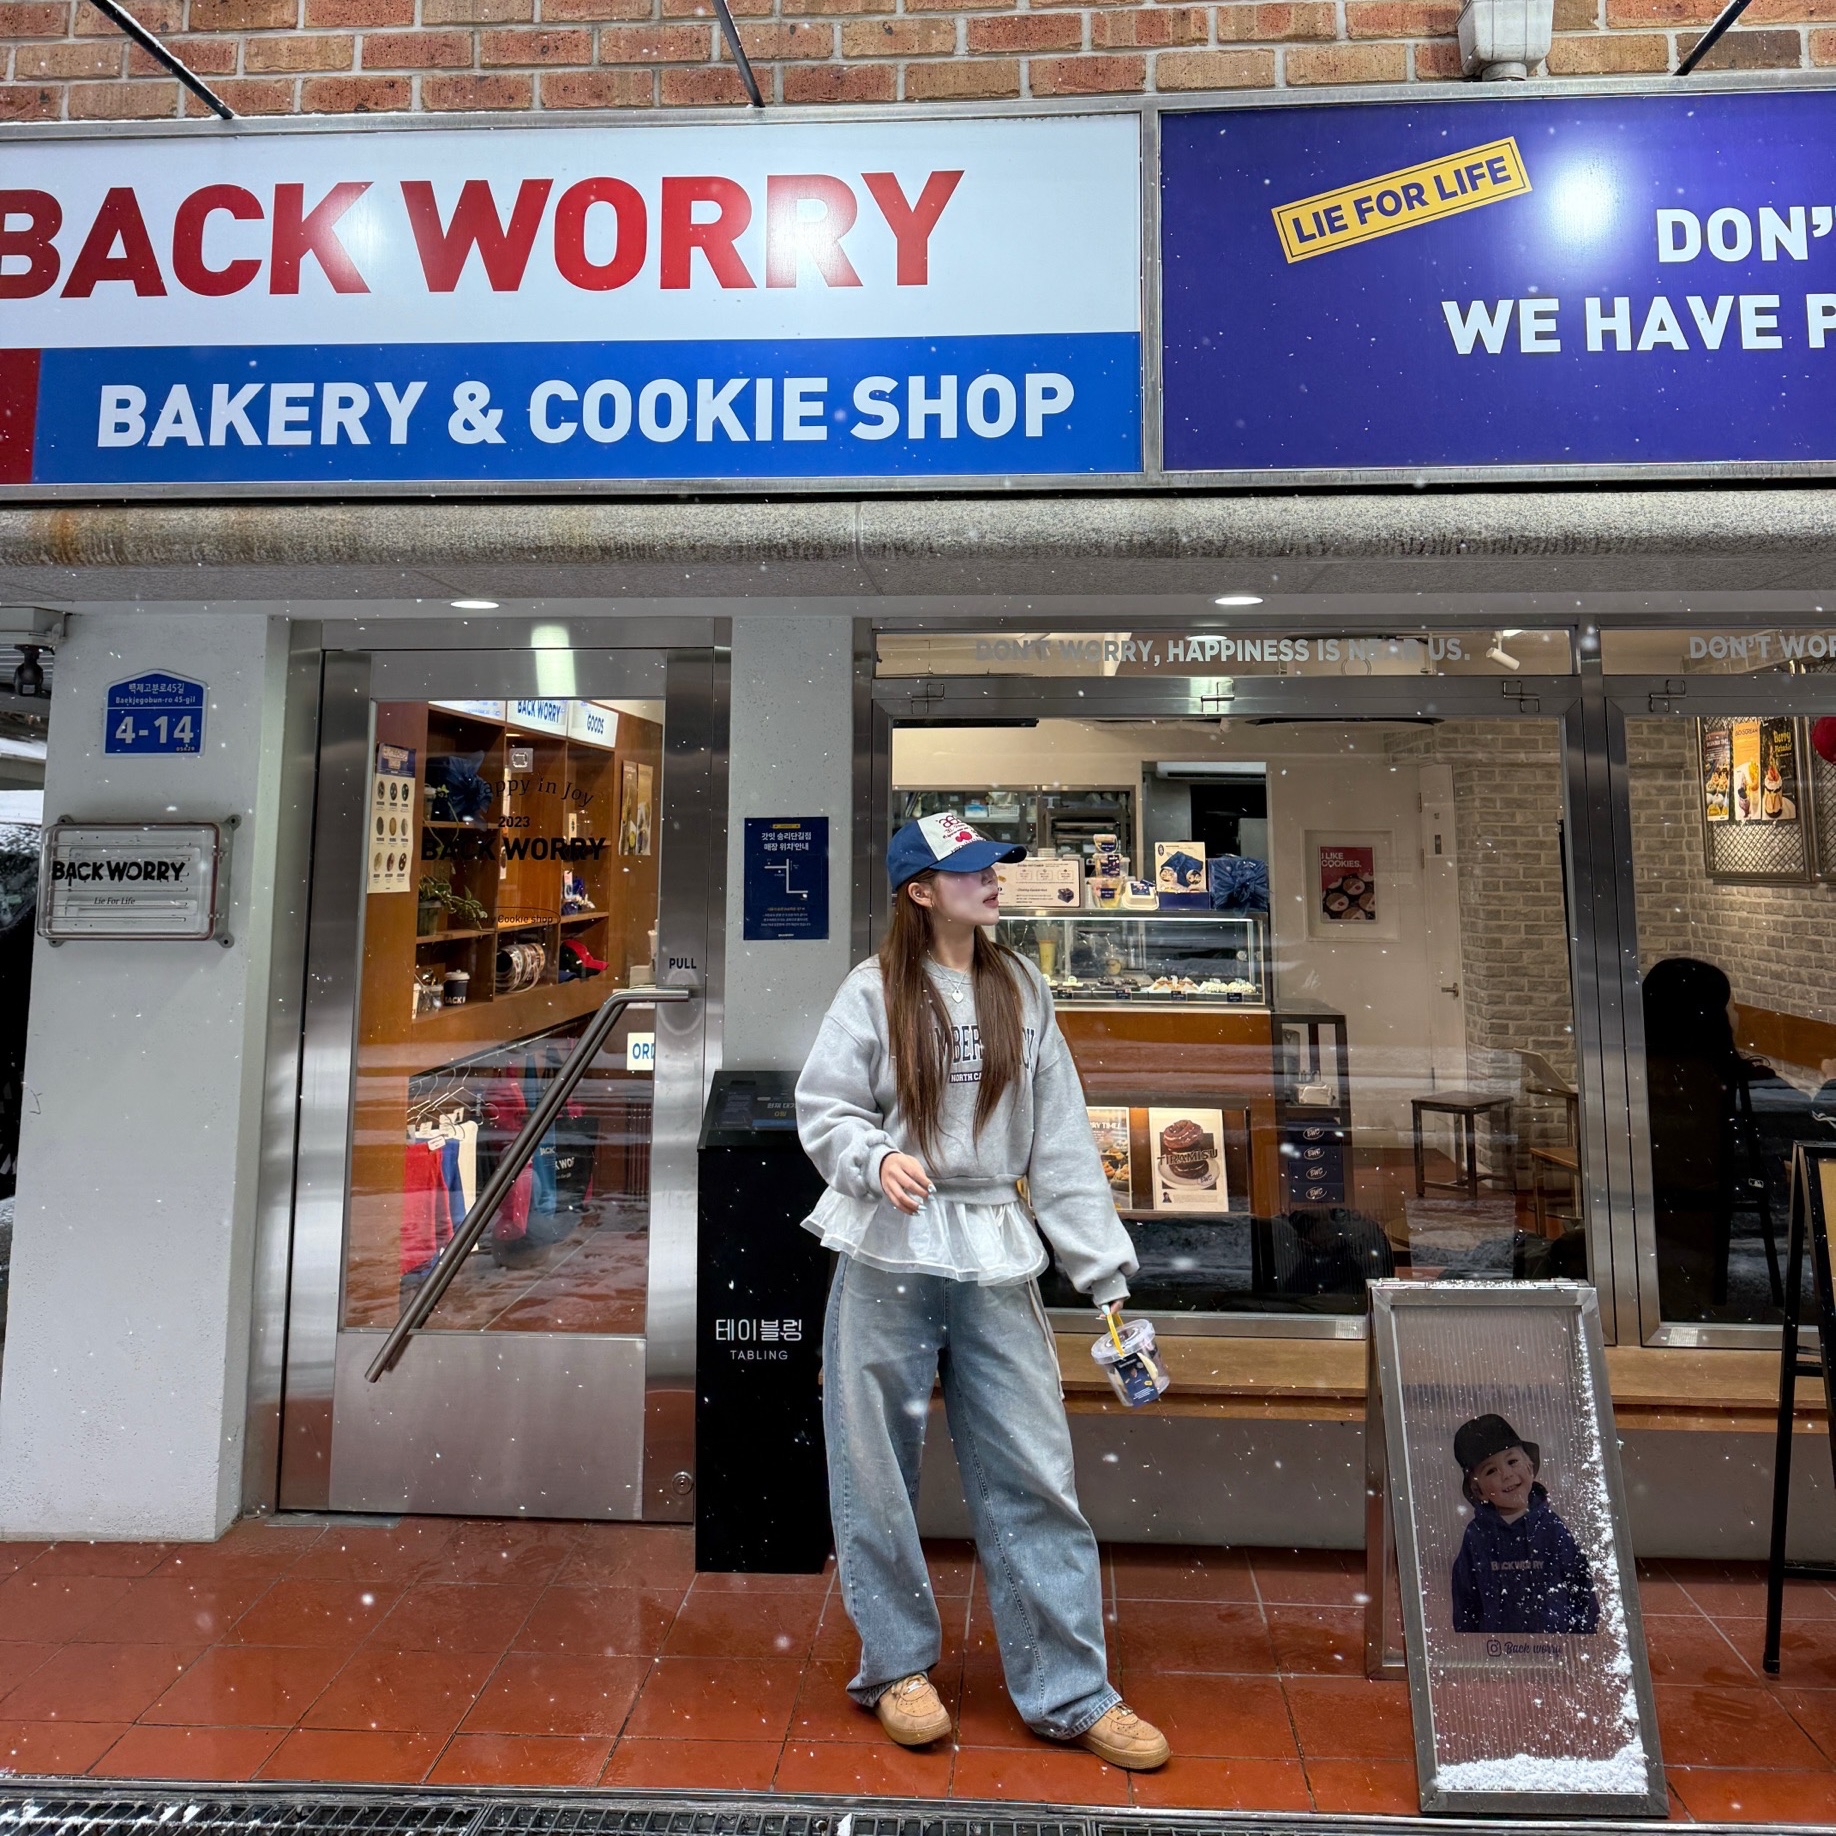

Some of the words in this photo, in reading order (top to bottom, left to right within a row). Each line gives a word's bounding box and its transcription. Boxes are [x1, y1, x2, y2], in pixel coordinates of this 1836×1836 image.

[1291, 205, 1349, 245] LIE
[1353, 182, 1430, 228] FOR
[1435, 155, 1513, 203] LIFE
[0, 181, 374, 298] BACK
[400, 170, 965, 292] WORRY
[1656, 206, 1836, 263] DON'
[1441, 298, 1561, 355] WE
[1585, 294, 1783, 351] HAVE
[97, 381, 428, 447] BAKERY
[447, 380, 507, 445] &
[529, 376, 828, 444] COOKIE
[850, 372, 1075, 441] SHOP
[974, 639, 1050, 662] DON'T
[1058, 638, 1161, 667] WORRY,
[1167, 638, 1310, 663] HAPPINESS
[1317, 638, 1341, 662] IS
[1428, 638, 1471, 661] US.
[1689, 635, 1771, 659] DON'T
[115, 696, 173, 705] Baekjegobun-ro
[174, 695, 196, 705] 45-gil
[128, 682, 185, 695] 백제고분로45길
[537, 700, 561, 724] WORRY
[115, 715, 194, 744] 4-14
[586, 713, 605, 735] GOODS
[538, 774, 557, 795] in
[561, 781, 595, 808] Joy
[498, 815, 531, 829] 2023
[420, 837, 498, 861] BACK
[502, 837, 607, 861] WORRY
[1325, 852, 1344, 860] LIKE
[51, 861, 104, 884] BACK
[106, 860, 186, 883] WORRY
[1321, 859, 1362, 868] COOKIES.
[94, 896, 106, 905] Lie
[106, 896, 120, 905] For
[120, 896, 136, 905] Life
[497, 913, 529, 924] Cookie
[531, 914, 554, 927] shop
[669, 957, 697, 970] PULL
[951, 1072, 972, 1083] NORTH
[1156, 1148, 1219, 1166] TIRAMISU
[715, 1318, 803, 1342] 테이블링
[729, 1349, 789, 1361] TABLING
[1504, 1641, 1531, 1655] Back
